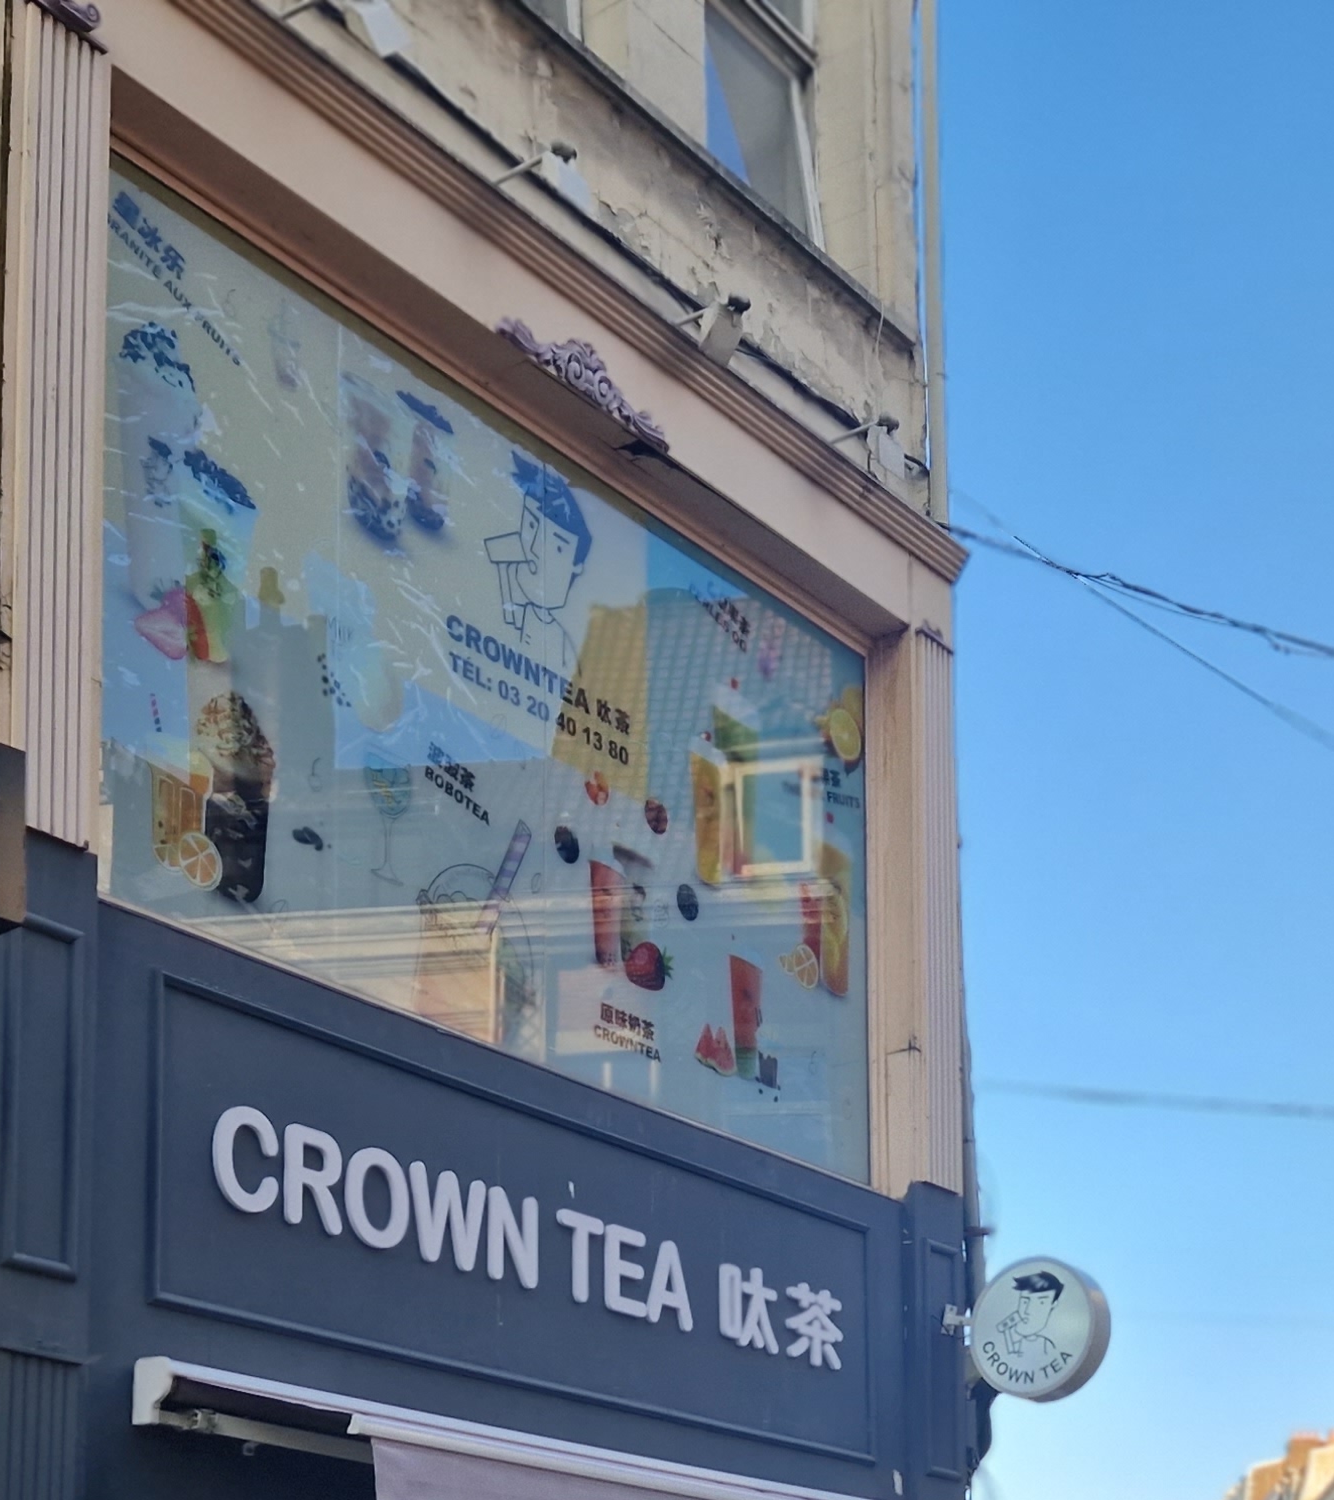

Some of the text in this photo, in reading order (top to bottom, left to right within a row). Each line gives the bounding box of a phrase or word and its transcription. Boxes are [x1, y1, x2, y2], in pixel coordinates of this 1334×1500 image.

[164, 279, 193, 311] AUX
[446, 615, 590, 715] CROWNTEA
[449, 651, 630, 766] TÉL: 03 20 40 13 80
[425, 765, 490, 826] BOBOTEA
[593, 1024, 661, 1062] CROWNTEA
[600, 1002, 655, 1041] 原味奶茶
[212, 1105, 693, 1333] CROWN TEA
[718, 1262, 844, 1370] 呔茶
[982, 1341, 1073, 1384] CROWN TEA
